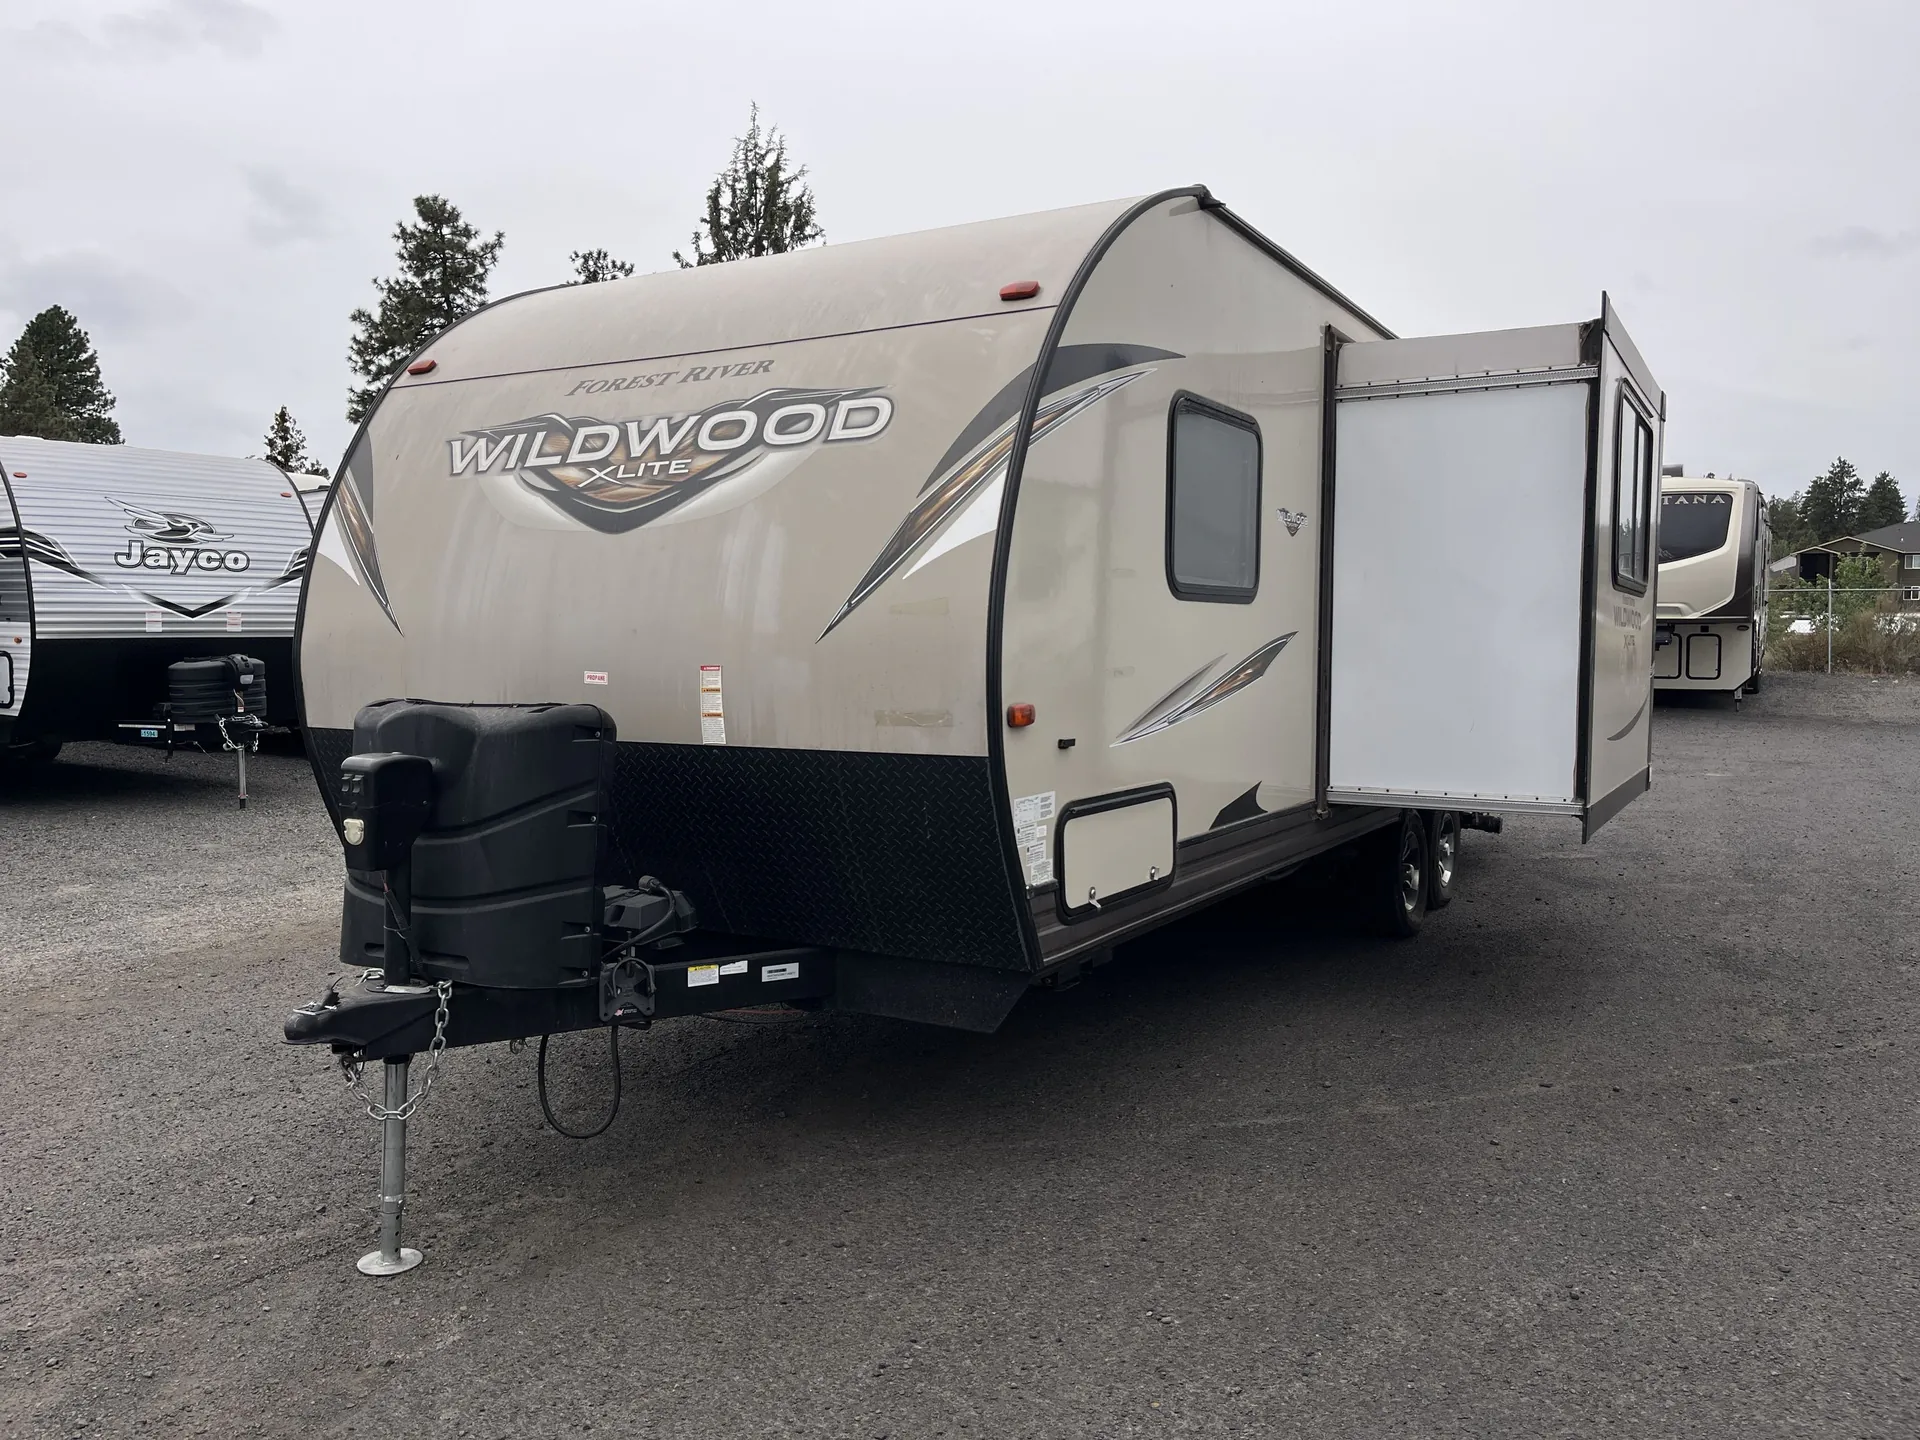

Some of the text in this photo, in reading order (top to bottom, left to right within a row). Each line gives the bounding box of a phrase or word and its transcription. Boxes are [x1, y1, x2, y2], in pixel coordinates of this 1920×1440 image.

[564, 359, 775, 396] FOREST RIVER
[448, 397, 894, 476] WILDWOOD
[114, 540, 250, 575] Jayco
